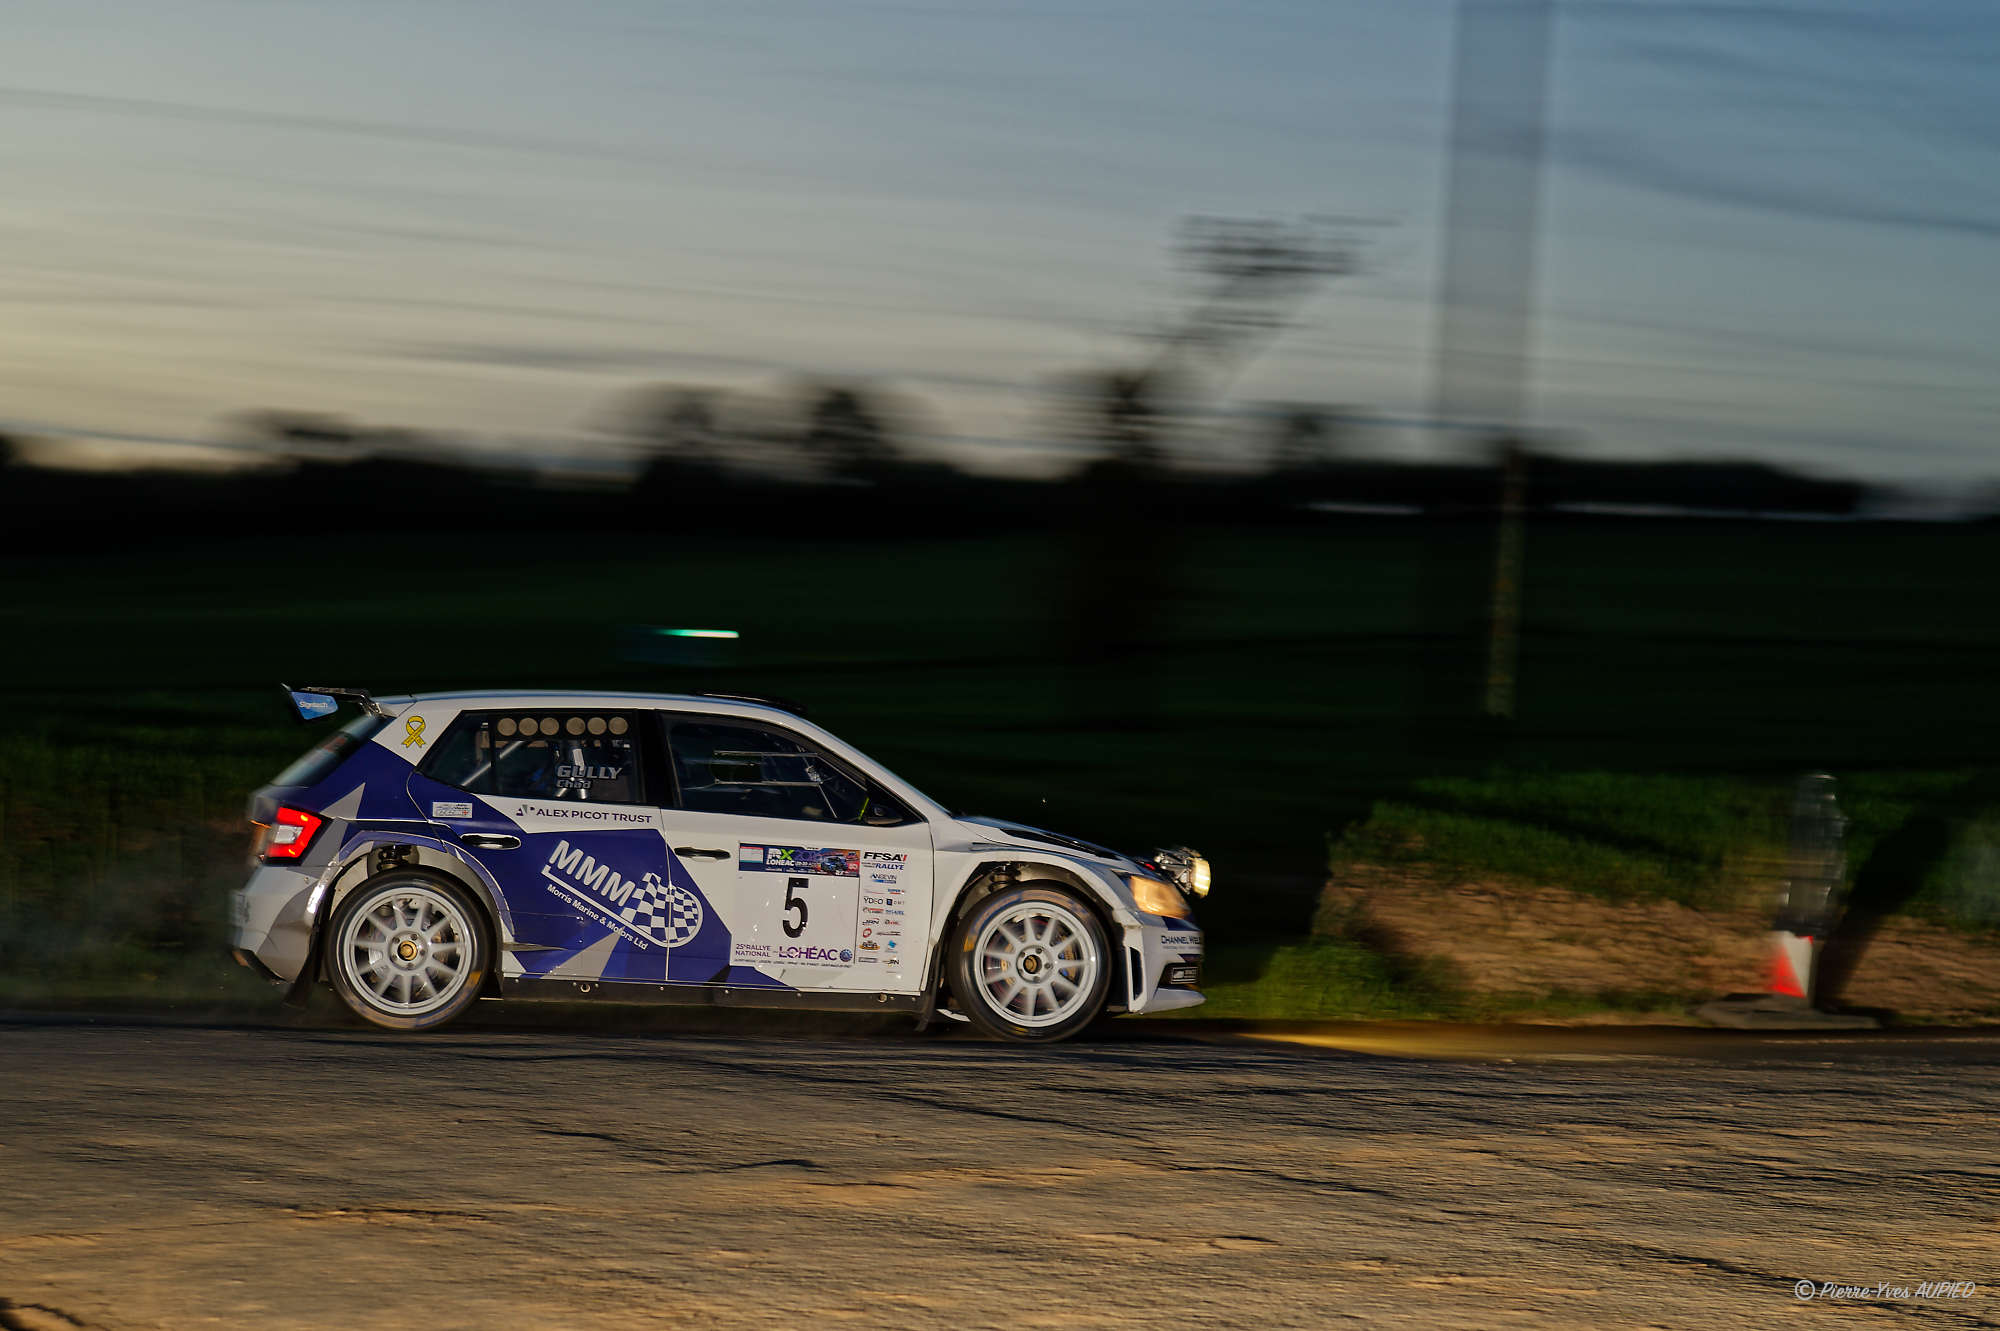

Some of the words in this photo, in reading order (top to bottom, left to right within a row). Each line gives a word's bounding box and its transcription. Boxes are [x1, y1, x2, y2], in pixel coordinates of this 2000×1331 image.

[557, 765, 622, 779] GULLY
[536, 808, 569, 818] ALEX
[571, 810, 609, 820] PICOT
[612, 813, 652, 823] TRUST
[864, 852, 902, 862] FFSA
[549, 839, 636, 907] MMM
[783, 877, 809, 938] 5
[547, 884, 573, 904] Morris
[572, 900, 599, 920] Marine
[599, 917, 607, 925] &
[606, 920, 634, 942] Motors
[633, 937, 649, 950] Ltd
[735, 950, 771, 958] NATIONAL
[779, 946, 838, 961] LOHÉAC
